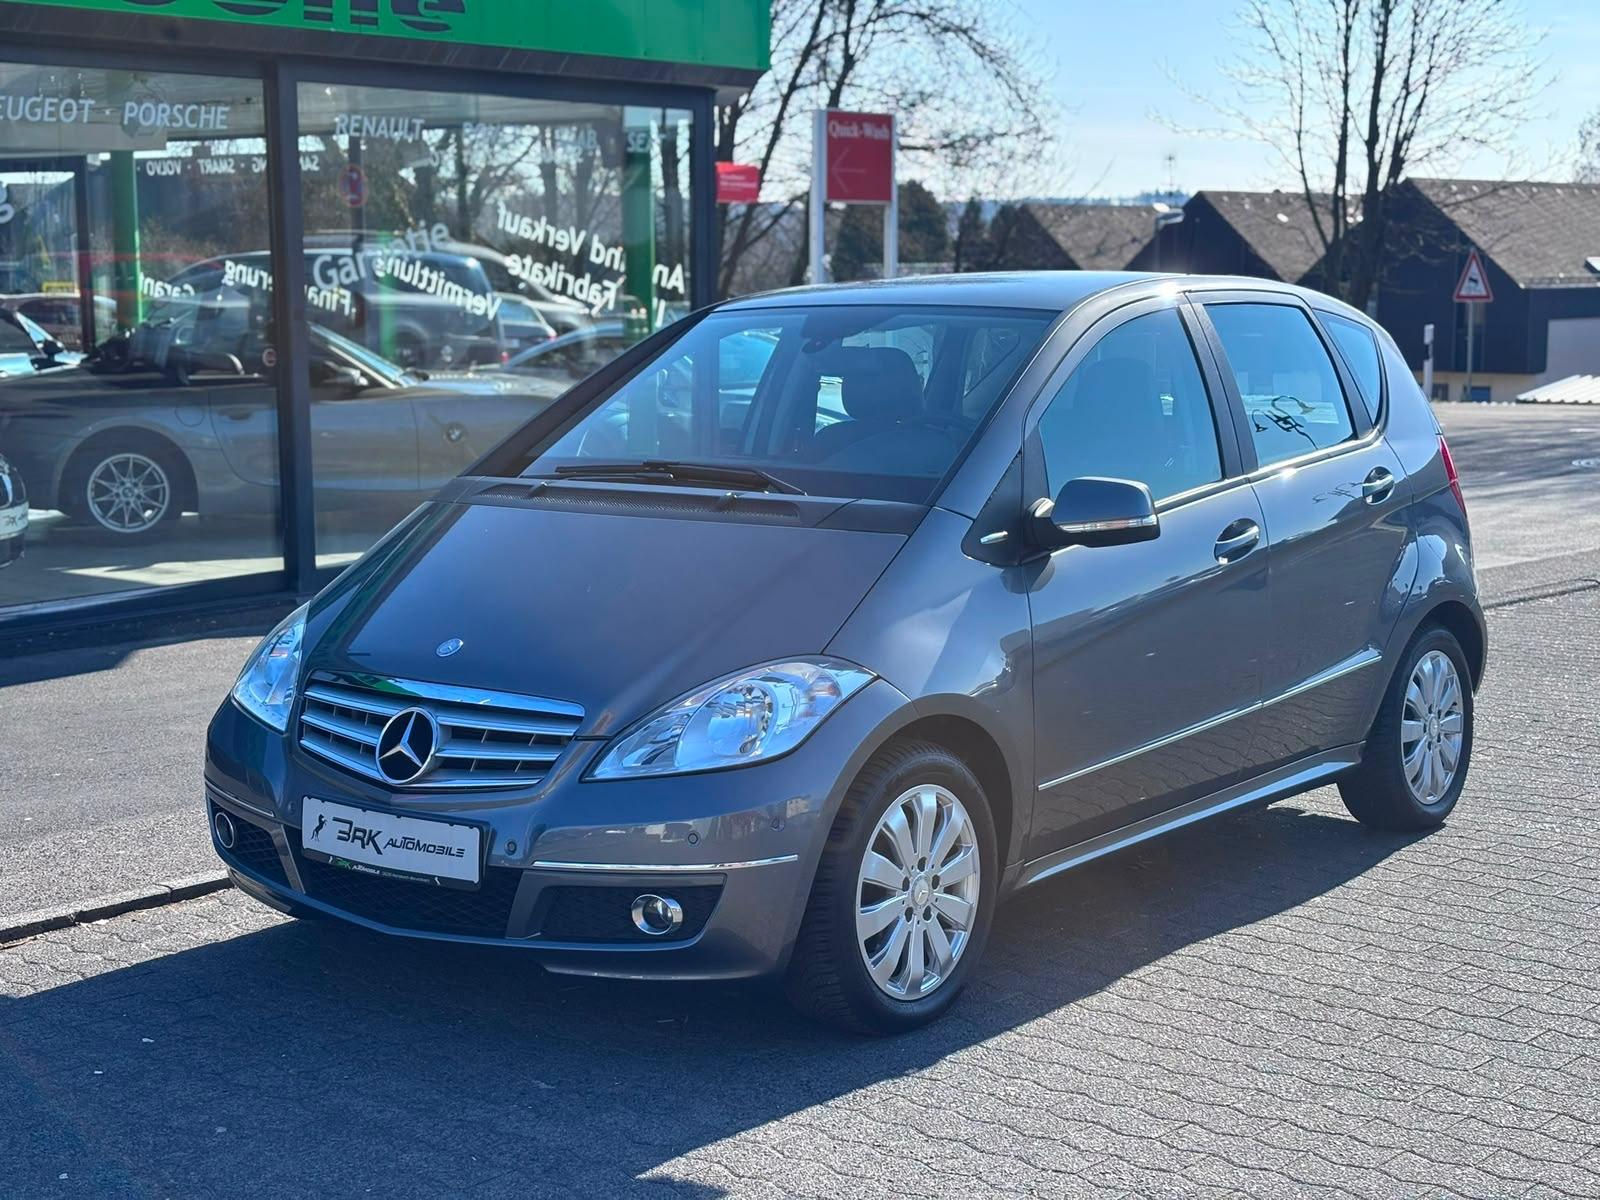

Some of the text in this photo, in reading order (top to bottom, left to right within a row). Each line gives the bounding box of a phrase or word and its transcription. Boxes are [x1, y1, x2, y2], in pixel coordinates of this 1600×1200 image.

[122, 101, 231, 130] PORSCHE
[334, 113, 426, 141] RENAULT
[383, 836, 466, 858] AUTOMOBILE
